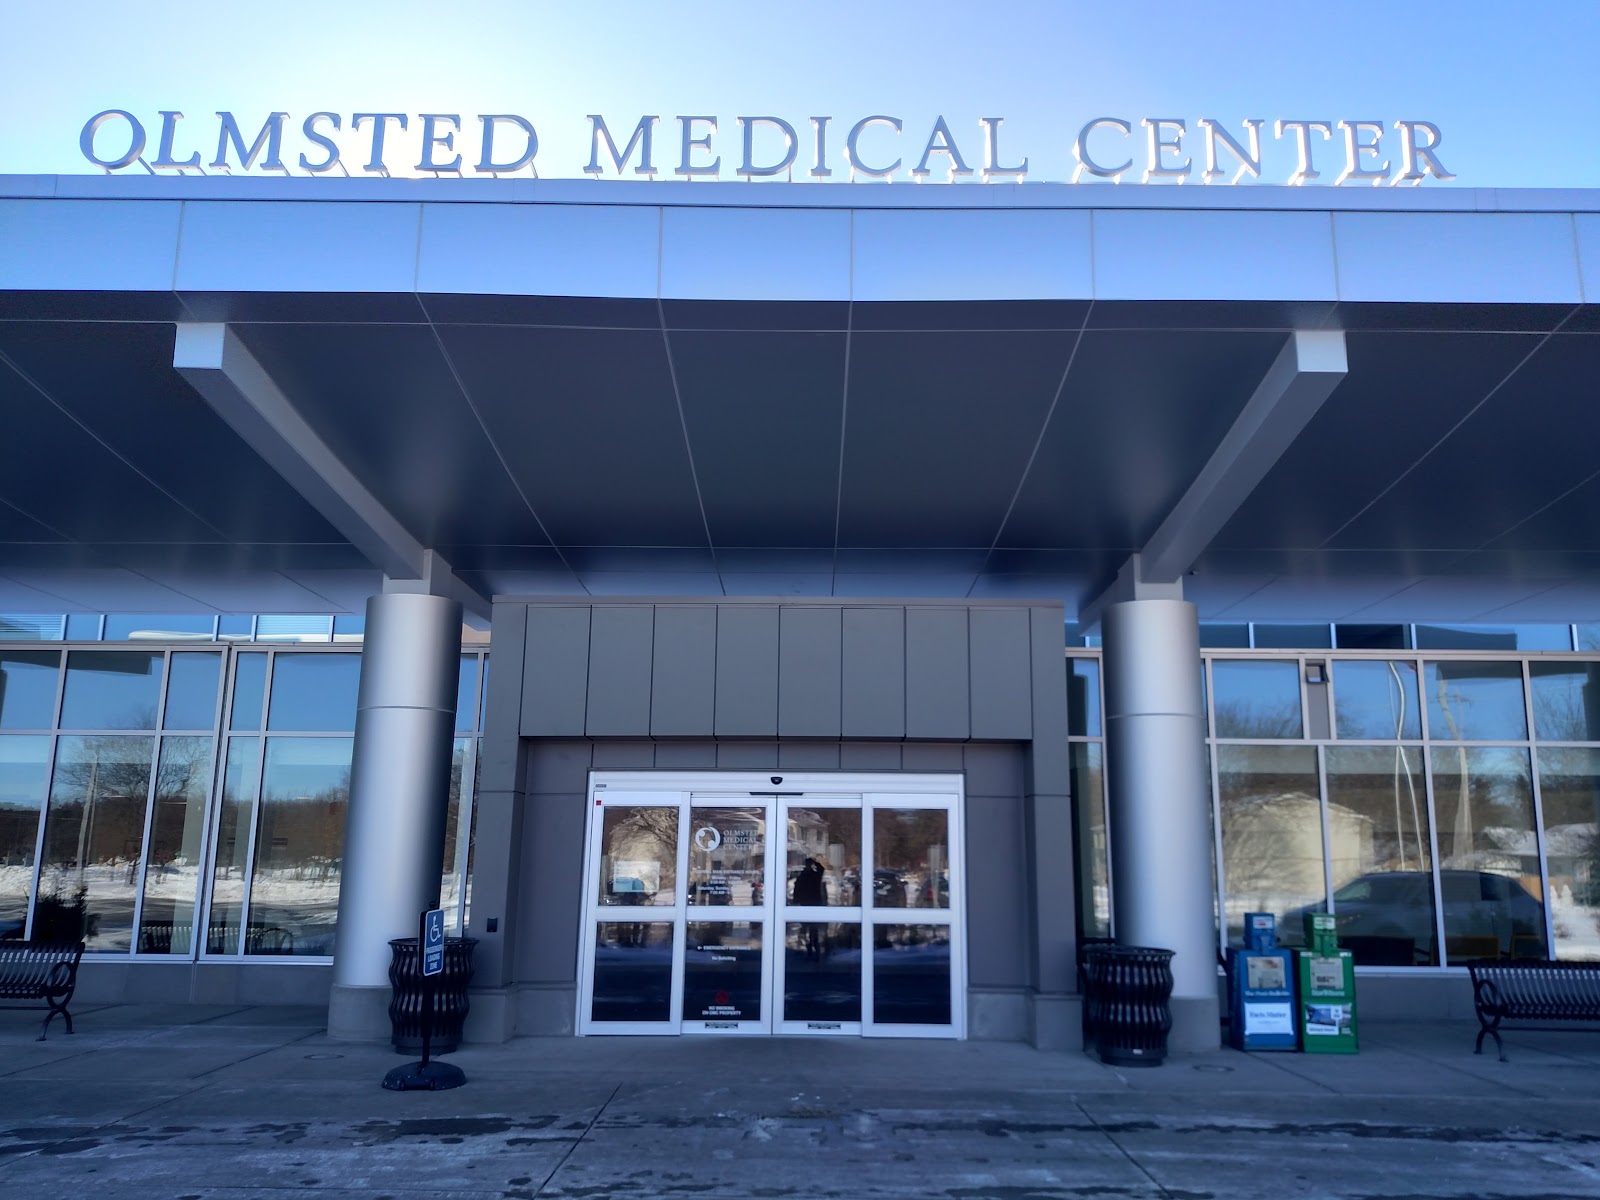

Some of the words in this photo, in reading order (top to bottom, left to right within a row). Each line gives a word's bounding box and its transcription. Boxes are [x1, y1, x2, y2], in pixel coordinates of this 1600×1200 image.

[79, 109, 539, 175] OLMSTED
[584, 114, 1030, 181] MEDICAL
[1074, 117, 1457, 184] CENTER
[428, 953, 440, 962] LOADING
[429, 962, 437, 970] ZONE
